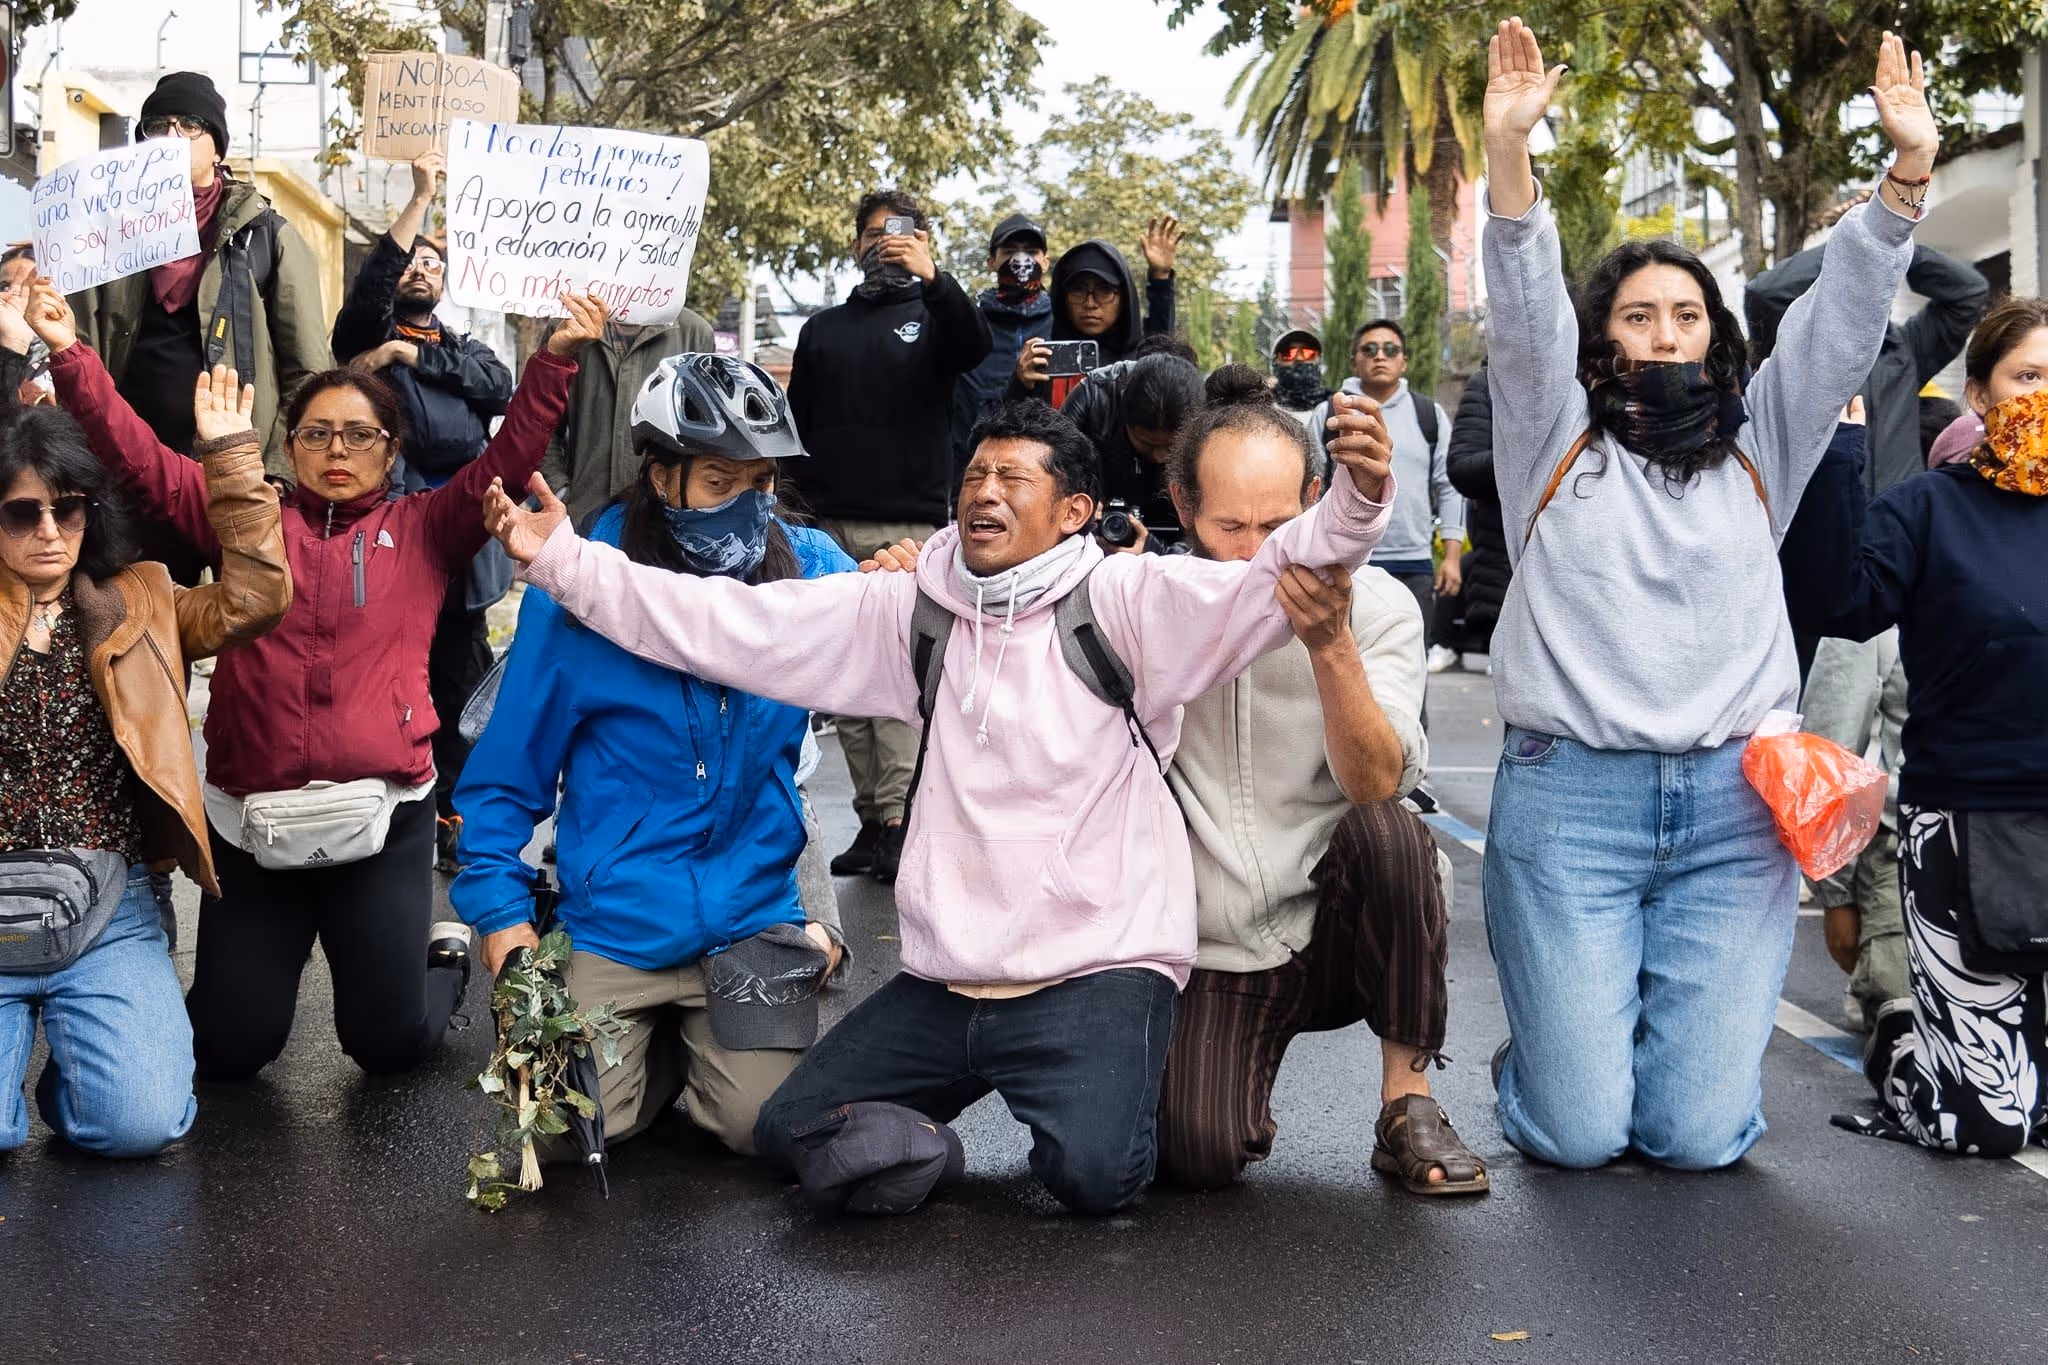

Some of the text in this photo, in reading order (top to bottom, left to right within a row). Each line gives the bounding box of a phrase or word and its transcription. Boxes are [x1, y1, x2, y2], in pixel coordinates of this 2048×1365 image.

[397, 58, 489, 92] NOBOA
[378, 91, 486, 114] MENTIROSO
[487, 123, 523, 154] No
[530, 137, 543, 156] a
[547, 126, 581, 158] los
[33, 168, 80, 205] Estoy
[37, 174, 184, 229] una vida digna
[455, 174, 556, 234] Apoyo
[563, 201, 582, 225] a
[592, 192, 612, 229] la
[37, 230, 62, 268] No
[73, 226, 109, 265] soy
[495, 225, 608, 263] educación
[615, 246, 631, 277] y
[458, 255, 507, 297] No
[522, 268, 572, 300] más
[501, 299, 526, 314] en
